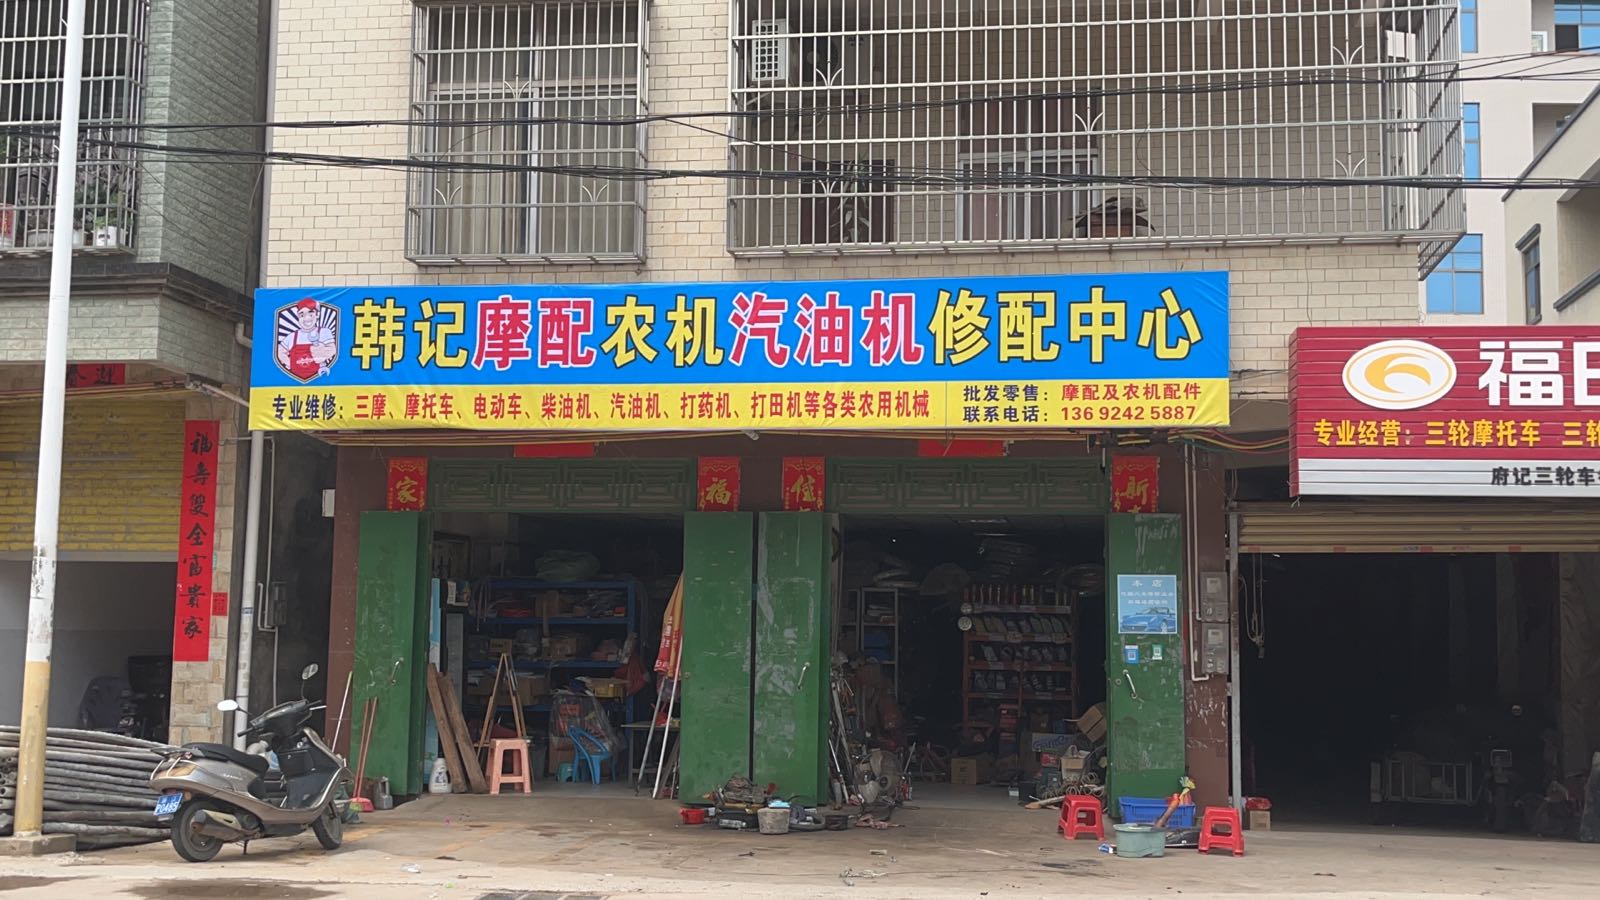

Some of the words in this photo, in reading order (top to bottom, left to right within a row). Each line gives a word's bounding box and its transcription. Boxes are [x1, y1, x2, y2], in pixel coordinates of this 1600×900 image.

[351, 286, 1204, 370] 韩记摩配农机汽油机修配中心
[395, 476, 419, 511] 家
[790, 474, 817, 511] 佳
[1119, 475, 1150, 511] 新
[1491, 466, 1600, 487] 府记三轮车
